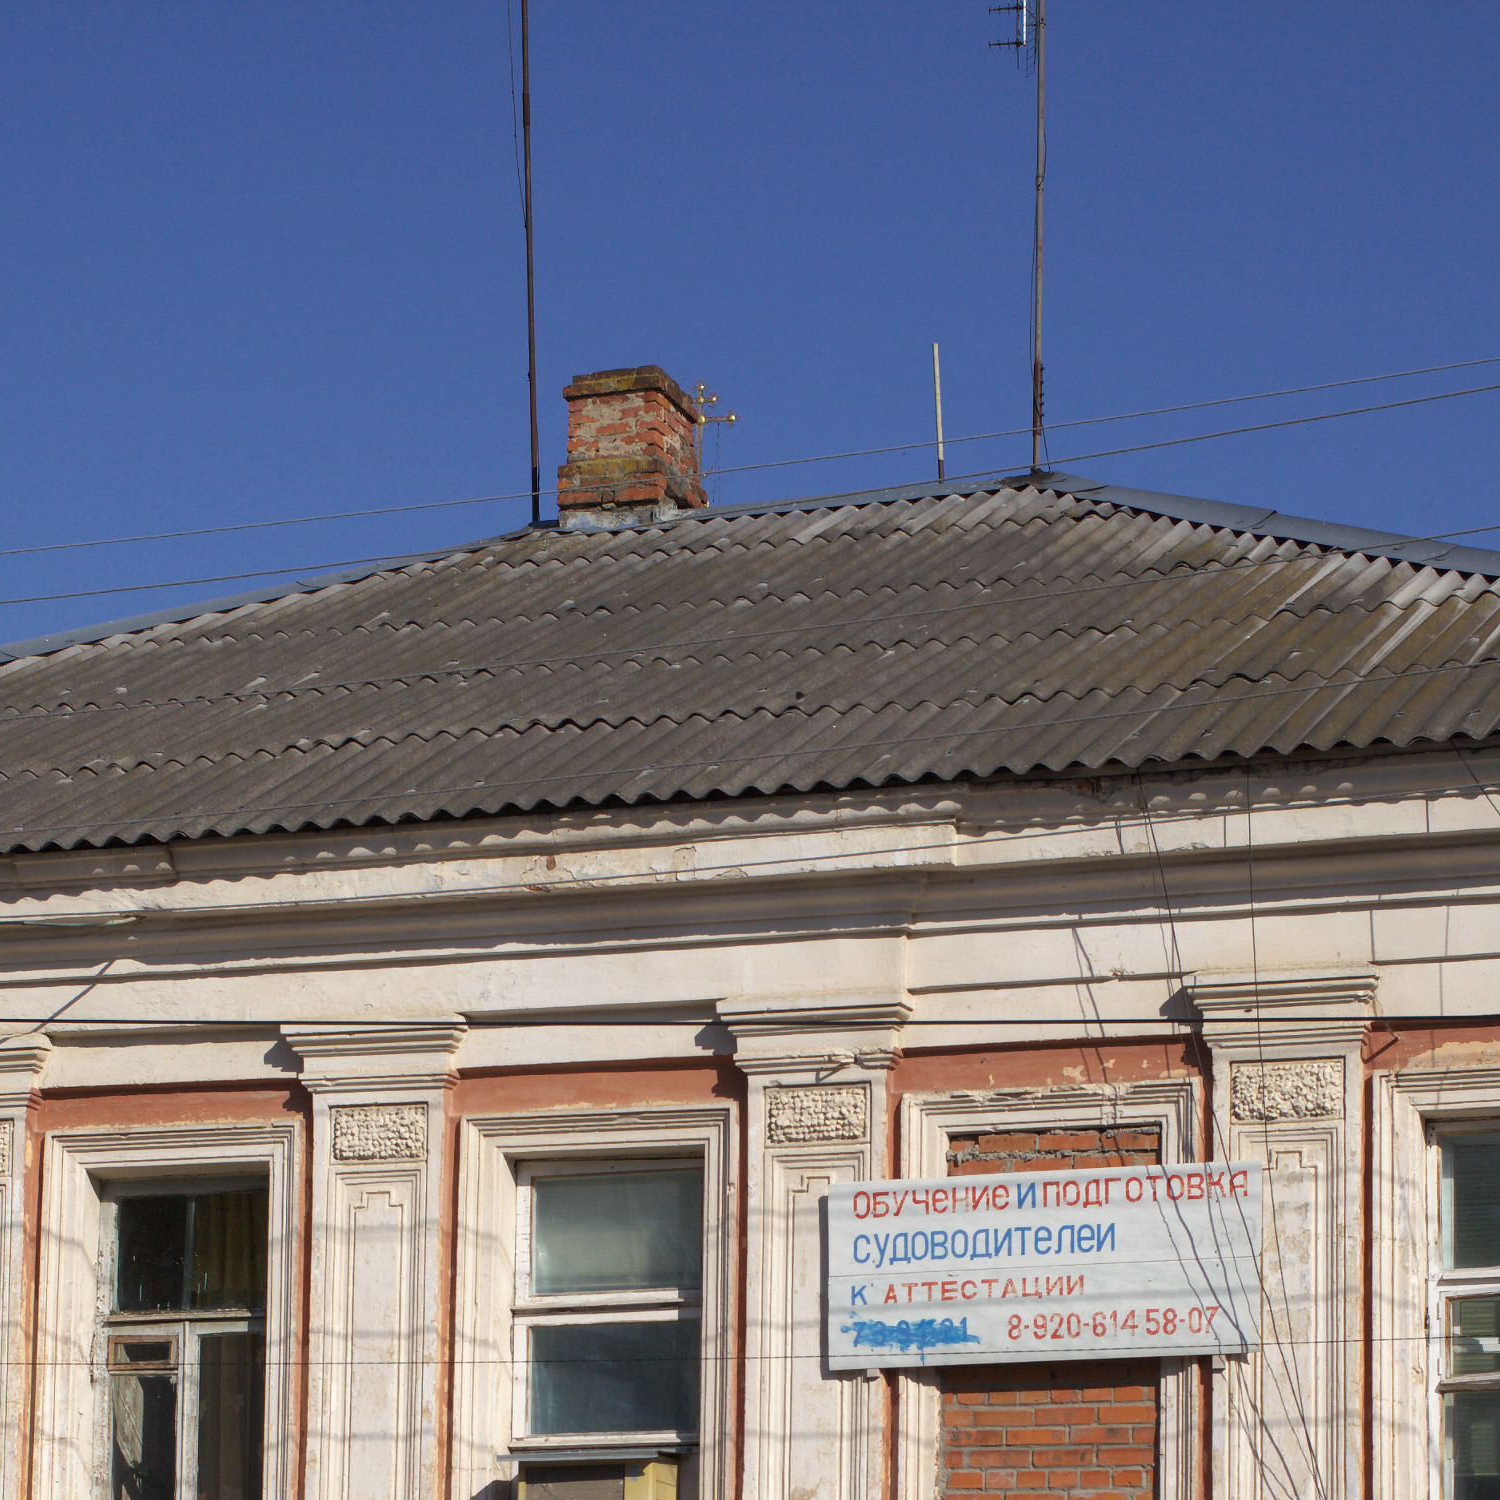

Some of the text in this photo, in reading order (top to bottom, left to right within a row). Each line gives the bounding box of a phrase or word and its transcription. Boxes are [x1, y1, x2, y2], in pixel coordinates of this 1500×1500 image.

[1017, 1182, 1037, 1210] И
[1042, 1170, 1249, 1210] ПОДГОТОВКА
[851, 1274, 1085, 1306] К АТТЕСТАЦИИ
